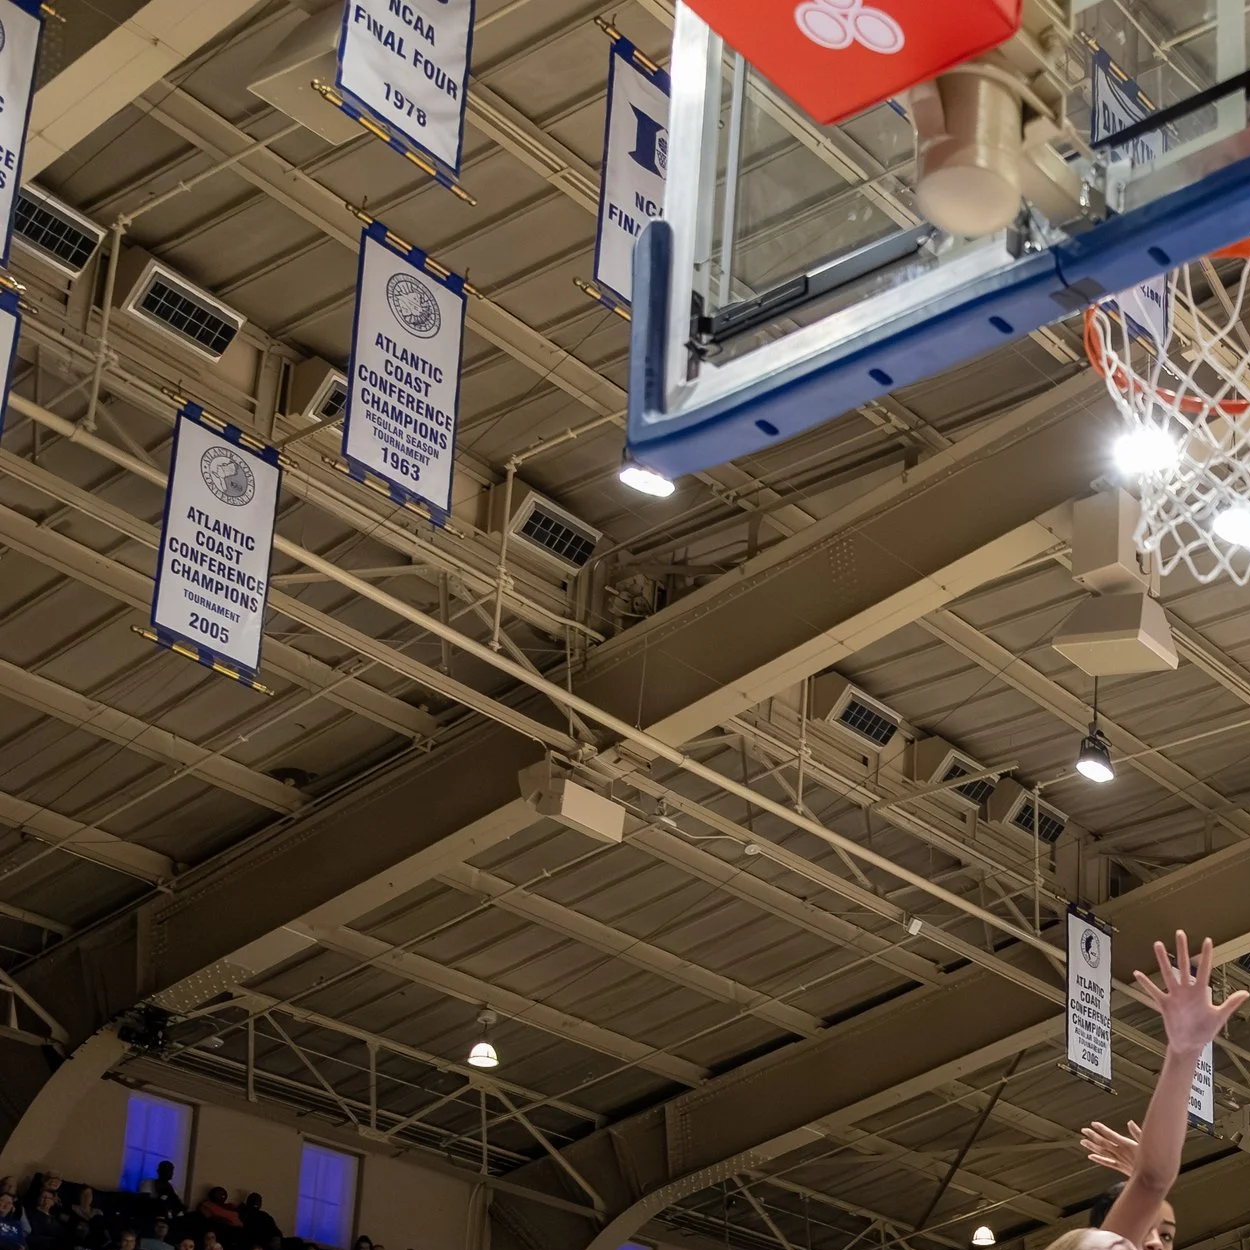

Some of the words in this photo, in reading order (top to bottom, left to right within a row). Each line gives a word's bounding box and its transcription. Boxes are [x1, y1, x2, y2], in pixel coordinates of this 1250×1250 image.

[389, 0, 435, 47] NCAA
[354, 4, 407, 60] FINAL
[413, 48, 458, 101] FOUR
[383, 81, 427, 127] 1978
[374, 332, 443, 384] ATLANTIC
[384, 359, 432, 398] COAST
[358, 364, 453, 432] CONFERENCE
[361, 387, 448, 450] CHAMPIONS
[365, 409, 404, 440] REGULAR
[406, 434, 440, 460] SEASON
[372, 426, 431, 466] TOURNAMENT
[381, 447, 421, 481] 1963
[187, 506, 256, 551] ATLANTIC
[195, 530, 243, 565] COAST
[169, 536, 265, 597] CONFERENCE
[171, 558, 259, 613] CHAMPIONS
[183, 588, 241, 623] TOURNAMENT
[188, 612, 230, 644] 2005
